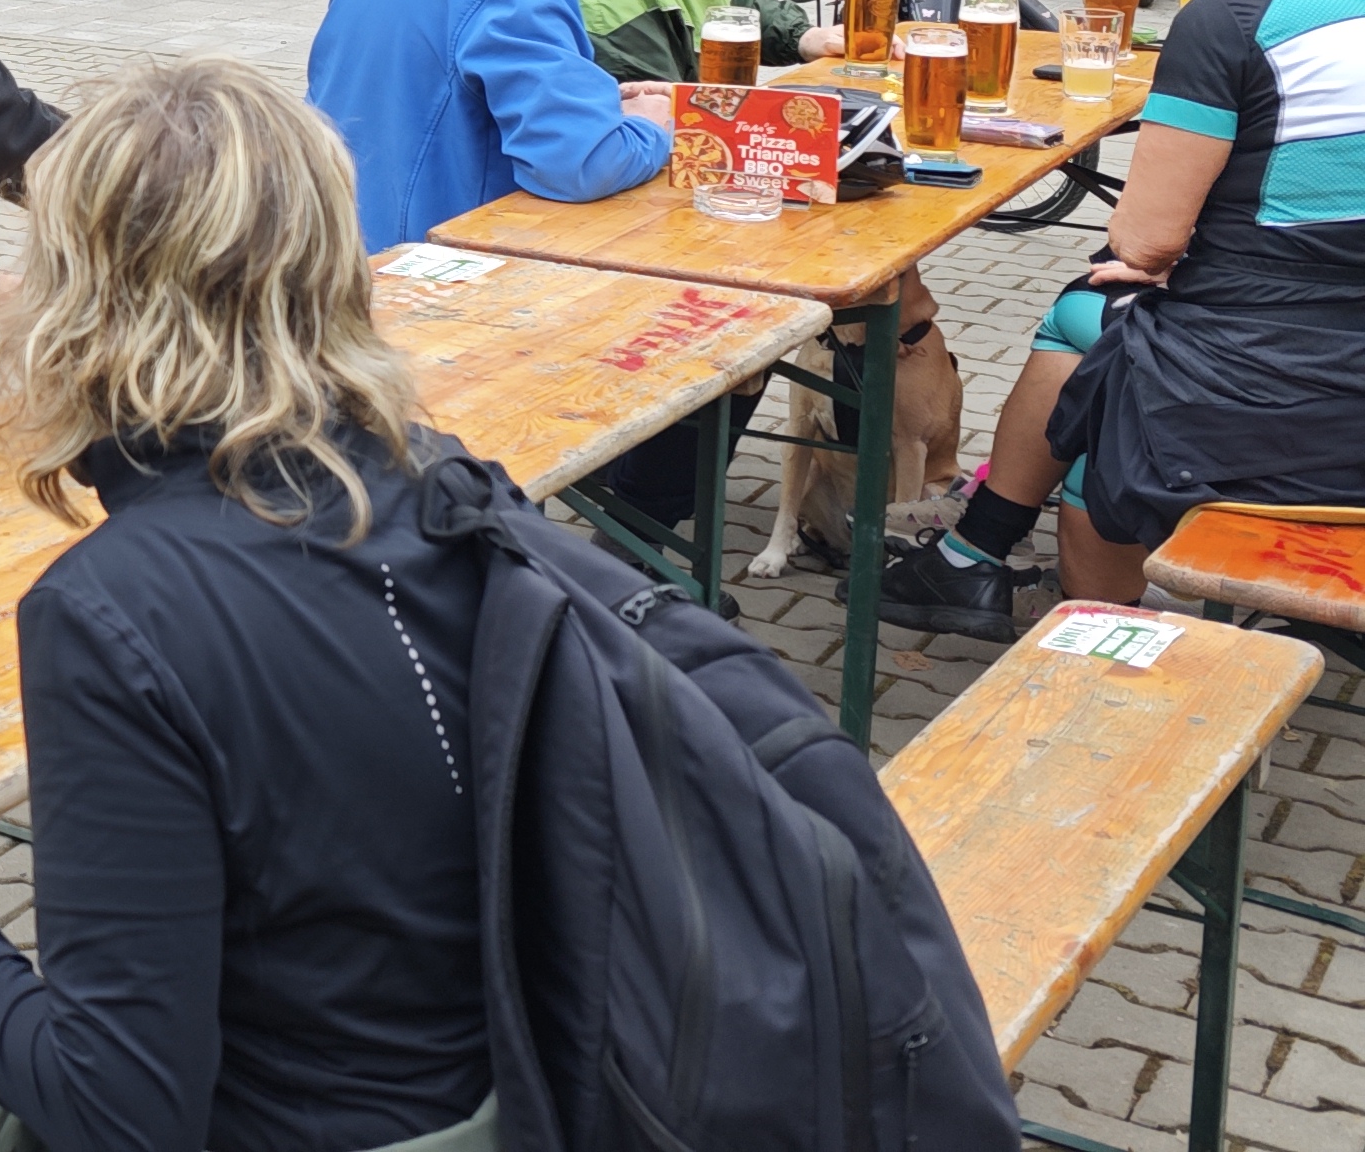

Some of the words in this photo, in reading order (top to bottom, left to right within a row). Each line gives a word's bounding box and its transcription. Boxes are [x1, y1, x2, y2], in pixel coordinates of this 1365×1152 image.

[734, 121, 777, 134] Tom's
[749, 134, 797, 151] Pizza
[737, 145, 820, 166] Triangles
[744, 160, 784, 175] BBQ
[733, 173, 790, 190] Sweet
